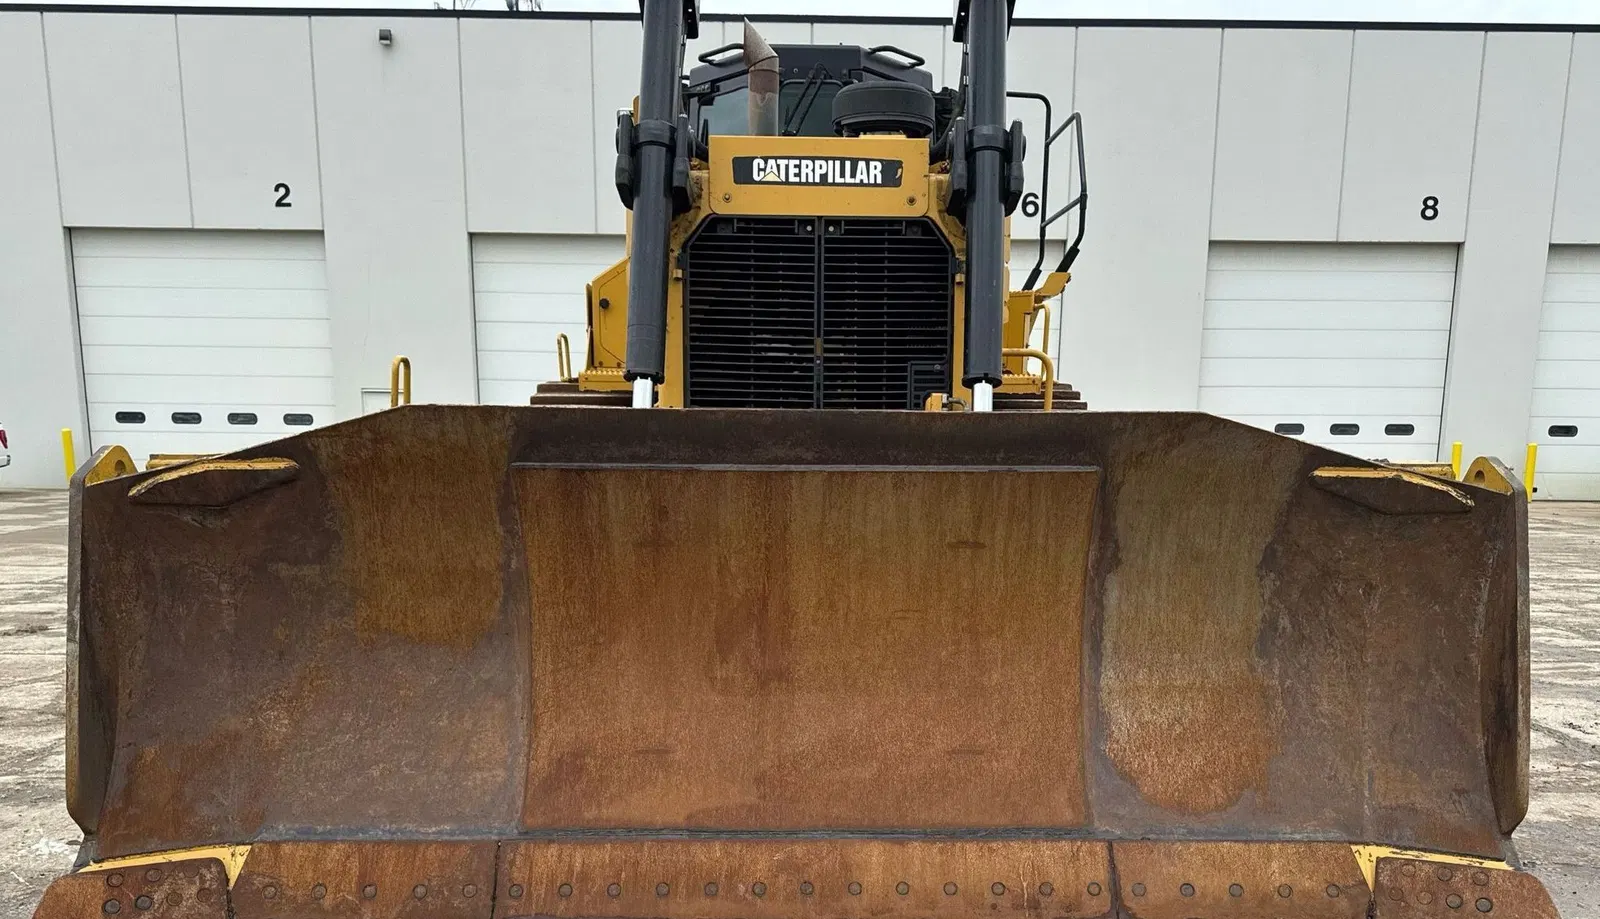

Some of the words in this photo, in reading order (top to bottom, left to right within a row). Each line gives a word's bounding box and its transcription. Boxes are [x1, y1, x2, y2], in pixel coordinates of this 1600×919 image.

[752, 158, 882, 184] CATERPILLAR
[274, 182, 292, 207] 2
[1021, 192, 1040, 218] 6
[1420, 195, 1439, 221] 8
